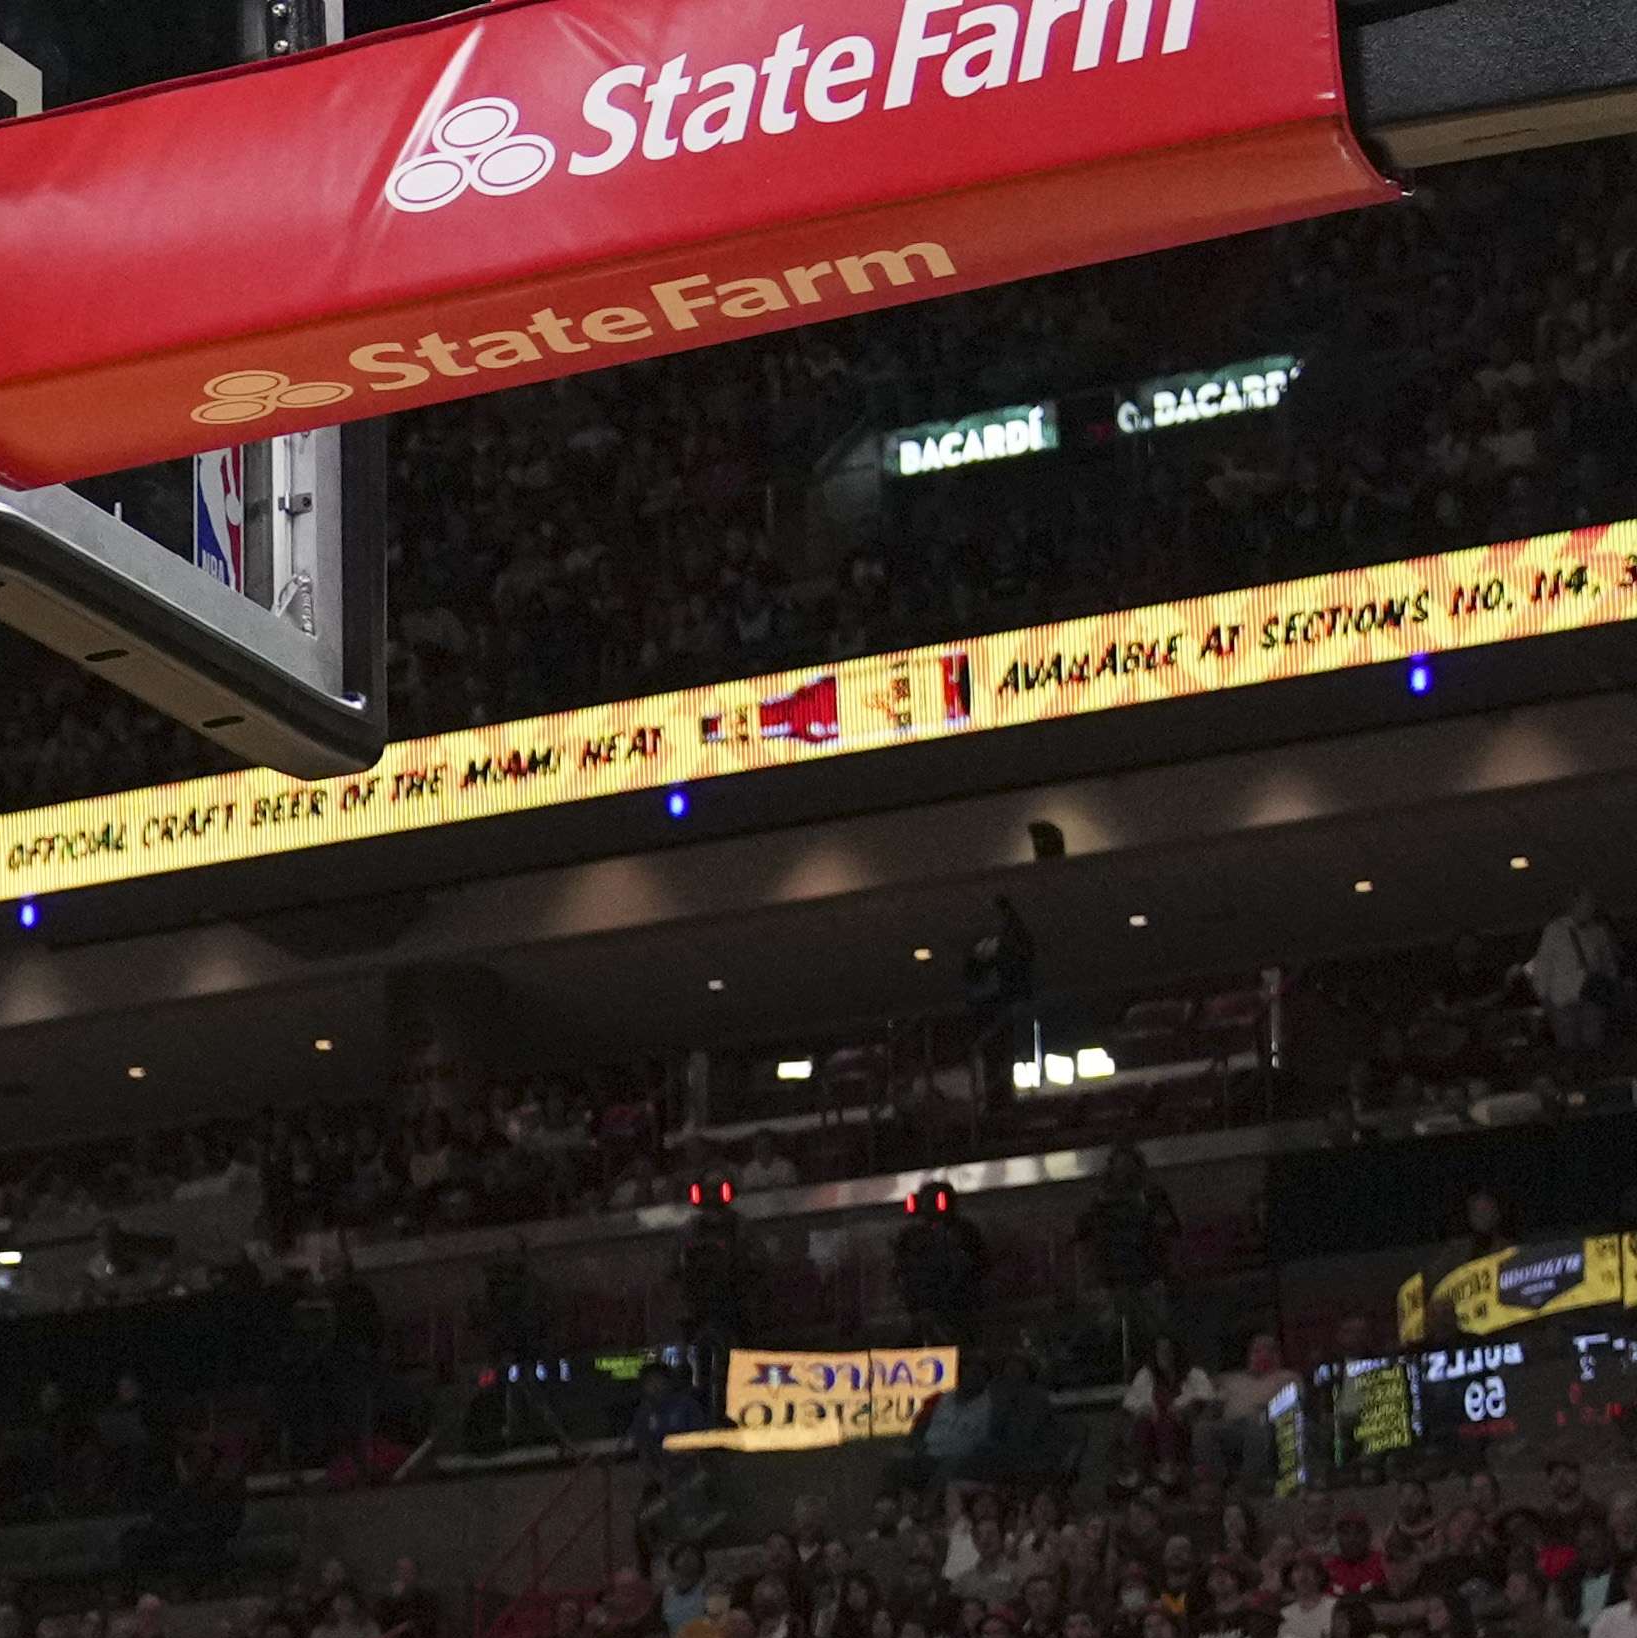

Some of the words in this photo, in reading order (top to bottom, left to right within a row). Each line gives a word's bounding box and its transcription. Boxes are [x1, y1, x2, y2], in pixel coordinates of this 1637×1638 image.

[997, 631, 1183, 697] AVAILABLE
[1198, 623, 1241, 661] AT
[1260, 589, 1431, 650] SECTIONS
[7, 822, 128, 870] OFFICIAL
[142, 802, 236, 848] CRAFT
[249, 787, 327, 827] BEER
[340, 775, 379, 813] OF
[389, 763, 447, 802] THE
[459, 746, 562, 792] MIAMI
[579, 724, 666, 772] HEAT
